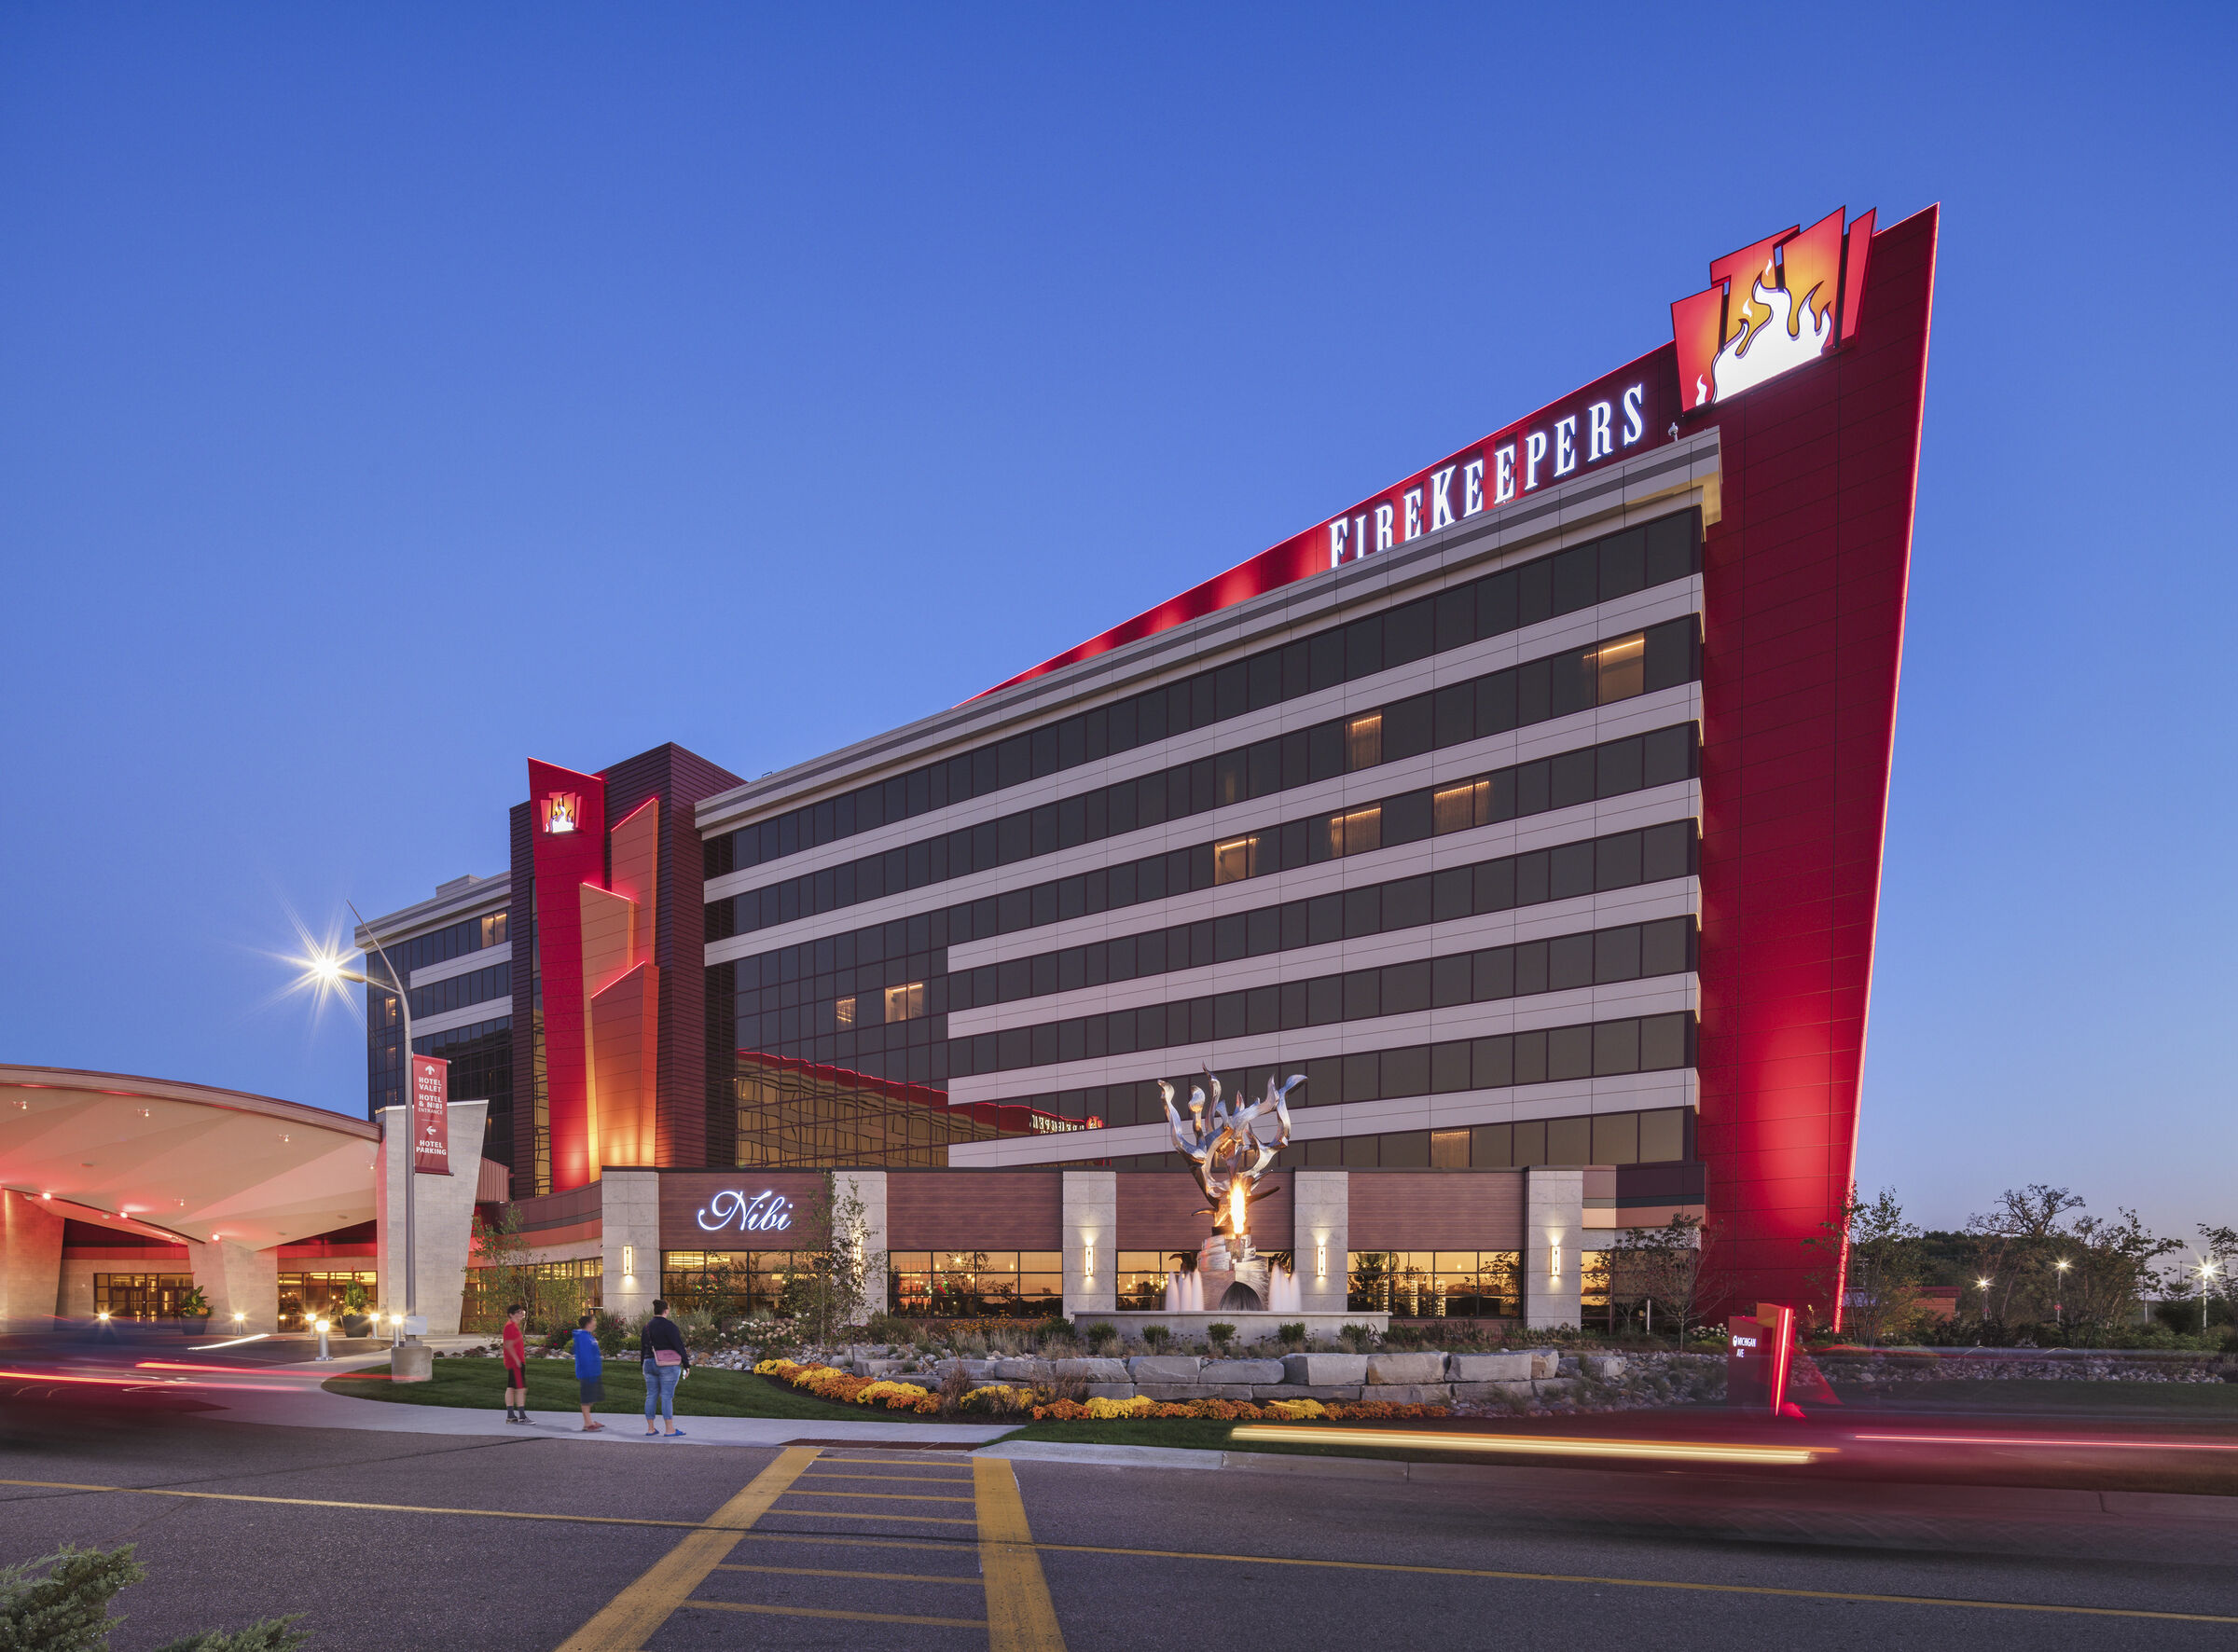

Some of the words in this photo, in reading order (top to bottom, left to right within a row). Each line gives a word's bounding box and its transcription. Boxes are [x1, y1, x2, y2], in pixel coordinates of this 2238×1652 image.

[419, 1077, 441, 1085] HOTEL
[416, 1147, 446, 1155] PARKING
[698, 1191, 792, 1231] Nibi
